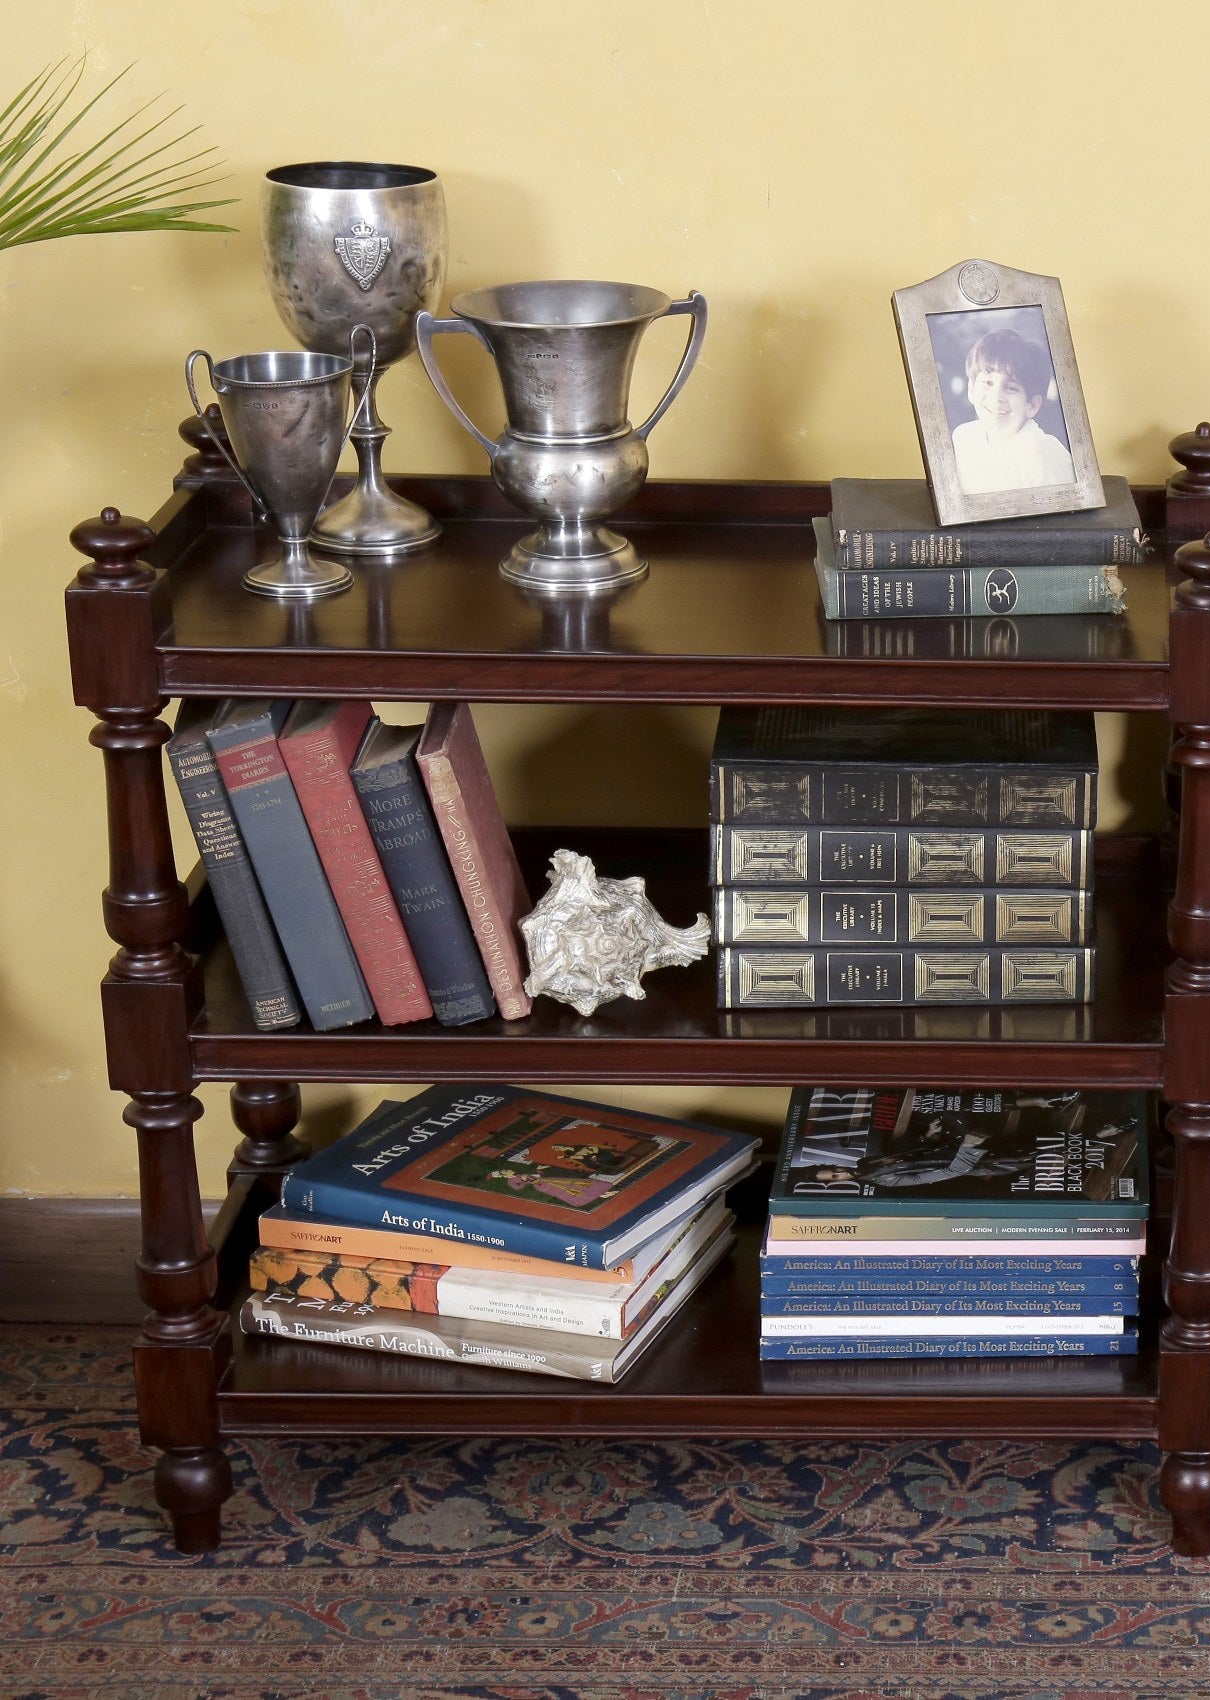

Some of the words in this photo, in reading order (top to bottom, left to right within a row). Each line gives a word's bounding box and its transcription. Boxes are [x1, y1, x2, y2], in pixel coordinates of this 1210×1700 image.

[229, 754, 274, 773] TORRINGTON
[241, 751, 255, 760] THE
[242, 767, 269, 780] DIARIES
[370, 794, 412, 814] MORE
[377, 828, 431, 850] ABROAD
[215, 852, 234, 860] Index
[453, 830, 485, 908] CHUNGKING
[402, 884, 438, 900] MARK
[402, 898, 445, 914] TWAIN
[480, 912, 513, 993] DESTINATION
[255, 996, 285, 1007] AMERICAN
[256, 1001, 289, 1012] TECHNICAL
[320, 999, 351, 1012] METHUEN
[259, 1008, 288, 1019] SOCIETY
[352, 1145, 410, 1176] Arts
[408, 1126, 437, 1143] of
[423, 1094, 495, 1128] India
[793, 1092, 875, 1195] BZAAR
[1068, 1133, 1083, 1160] BOOK
[1085, 1139, 1116, 1169] 2017
[1035, 1132, 1066, 1192] BRIDAL
[1011, 1175, 1030, 1192] The
[1067, 1162, 1082, 1192] BLACK
[381, 1210, 409, 1227] Arts
[412, 1217, 428, 1231] of
[430, 1219, 465, 1239] India
[468, 1233, 505, 1246] 1550-1900
[791, 1225, 858, 1234] SAFFRONART
[291, 1232, 342, 1243] SAFFRONART
[784, 1260, 831, 1270] America:
[834, 1260, 850, 1270] An
[853, 1259, 909, 1270] Illustrated
[912, 1260, 943, 1272] Diary
[945, 1259, 957, 1269] of
[959, 1260, 973, 1269] Its
[976, 1260, 1004, 1270] Most
[1007, 1260, 1052, 1272] Exciting
[1053, 1260, 1082, 1270] Years
[469, 1305, 494, 1313] Creative
[495, 1308, 530, 1318] Inspirations
[563, 1317, 584, 1326] Design
[489, 1300, 513, 1308] Western
[515, 1303, 534, 1311] Artists
[549, 1307, 564, 1315] India
[255, 1318, 289, 1335] The
[293, 1322, 375, 1347] Furniture
[379, 1334, 455, 1359] Machine
[1110, 1341, 1119, 1351] 21
[462, 1342, 501, 1356] Furniture
[502, 1349, 525, 1359] since
[528, 1354, 546, 1363] 1990
[787, 1345, 835, 1355] America:
[838, 1344, 854, 1354] An
[857, 1343, 912, 1353] Illustrated
[915, 1343, 948, 1355] Diary
[949, 1342, 961, 1352] of
[964, 1342, 976, 1352] Its
[979, 1342, 1007, 1352] Most
[1010, 1341, 1054, 1353] Exciting
[1056, 1340, 1084, 1351] Years
[462, 1353, 491, 1364] Gareth
[493, 1357, 532, 1370] Williams
